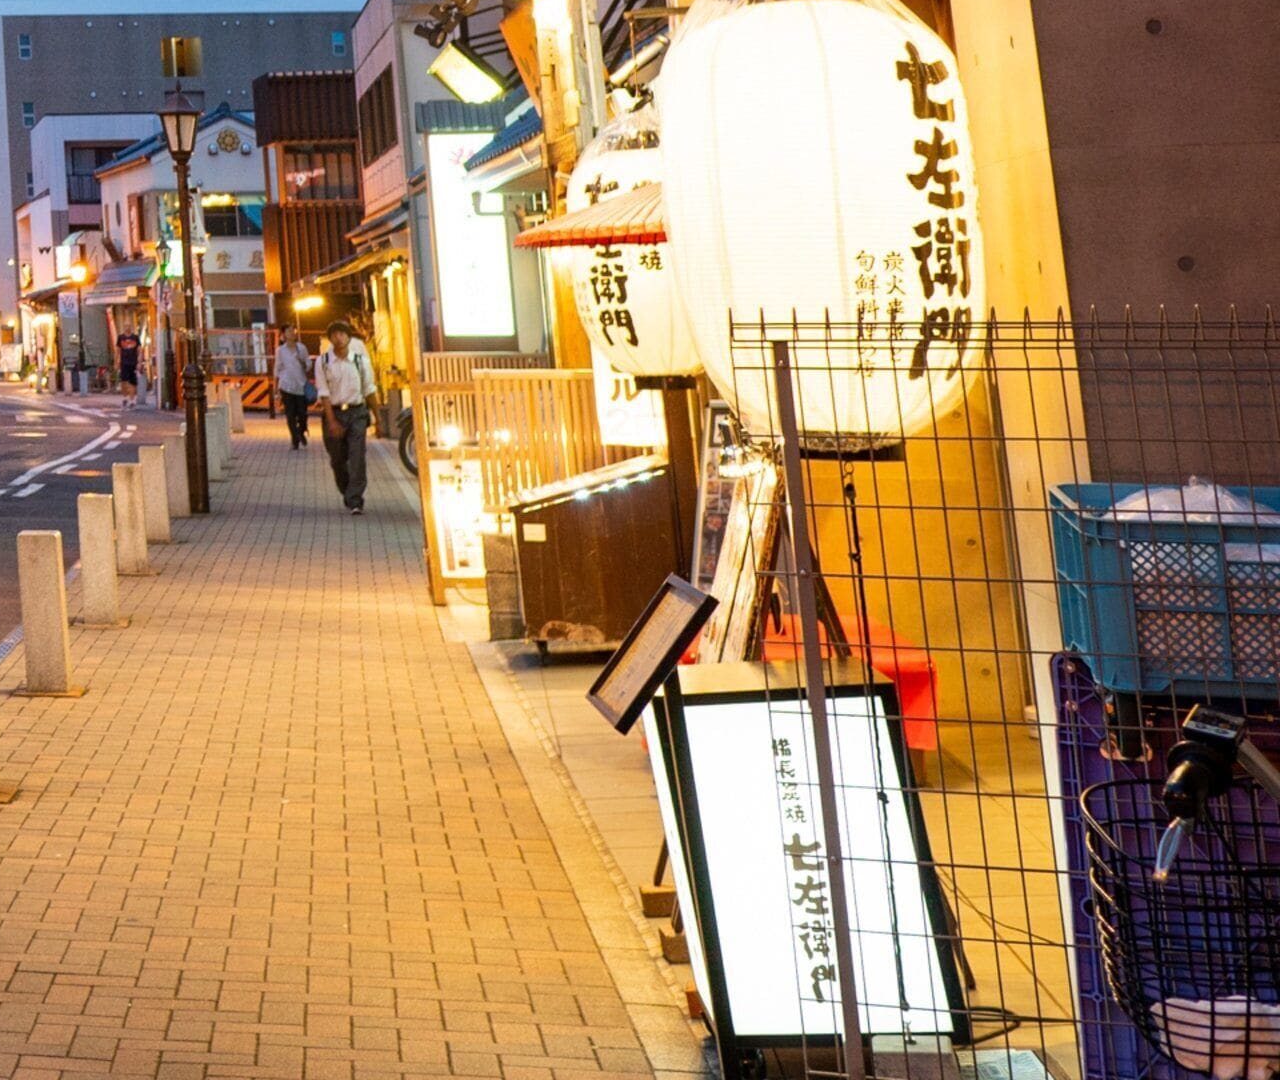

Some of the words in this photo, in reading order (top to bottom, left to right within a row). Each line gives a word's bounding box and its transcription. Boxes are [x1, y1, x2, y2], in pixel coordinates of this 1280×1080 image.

[895, 40, 972, 381] 七左衛門
[784, 832, 837, 1004] 七左衛門
